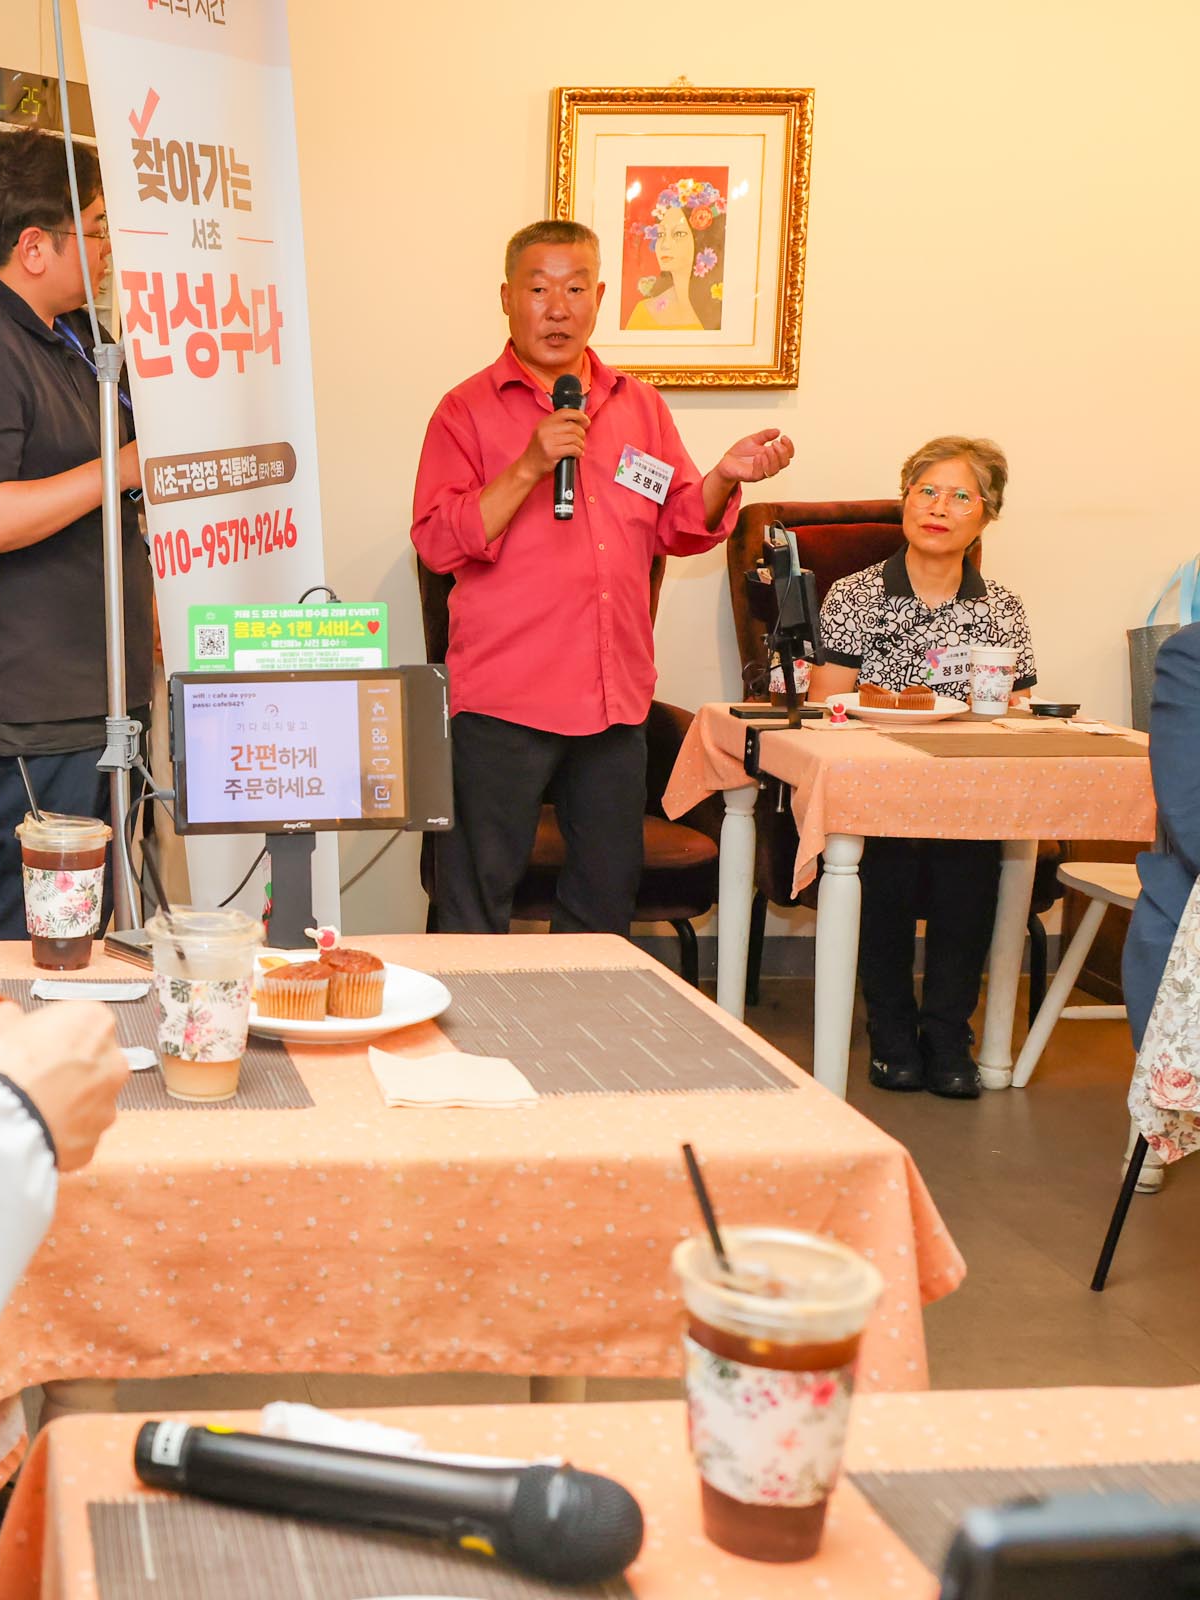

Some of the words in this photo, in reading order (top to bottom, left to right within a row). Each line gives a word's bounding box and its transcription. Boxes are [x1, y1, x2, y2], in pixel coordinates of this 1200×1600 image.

[131, 137, 253, 212] 찾아가는
[191, 218, 223, 250] 서초
[153, 459, 219, 497] 서초구청장
[220, 453, 258, 487] 직통번호
[632, 471, 663, 495] 조명래
[154, 507, 298, 579] 010-9579-9246
[234, 620, 283, 639] 음료수
[286, 620, 313, 638] 1캔
[316, 619, 366, 637] 서비스
[230, 743, 318, 771] 간편하게
[223, 776, 325, 800] 주문하세요
